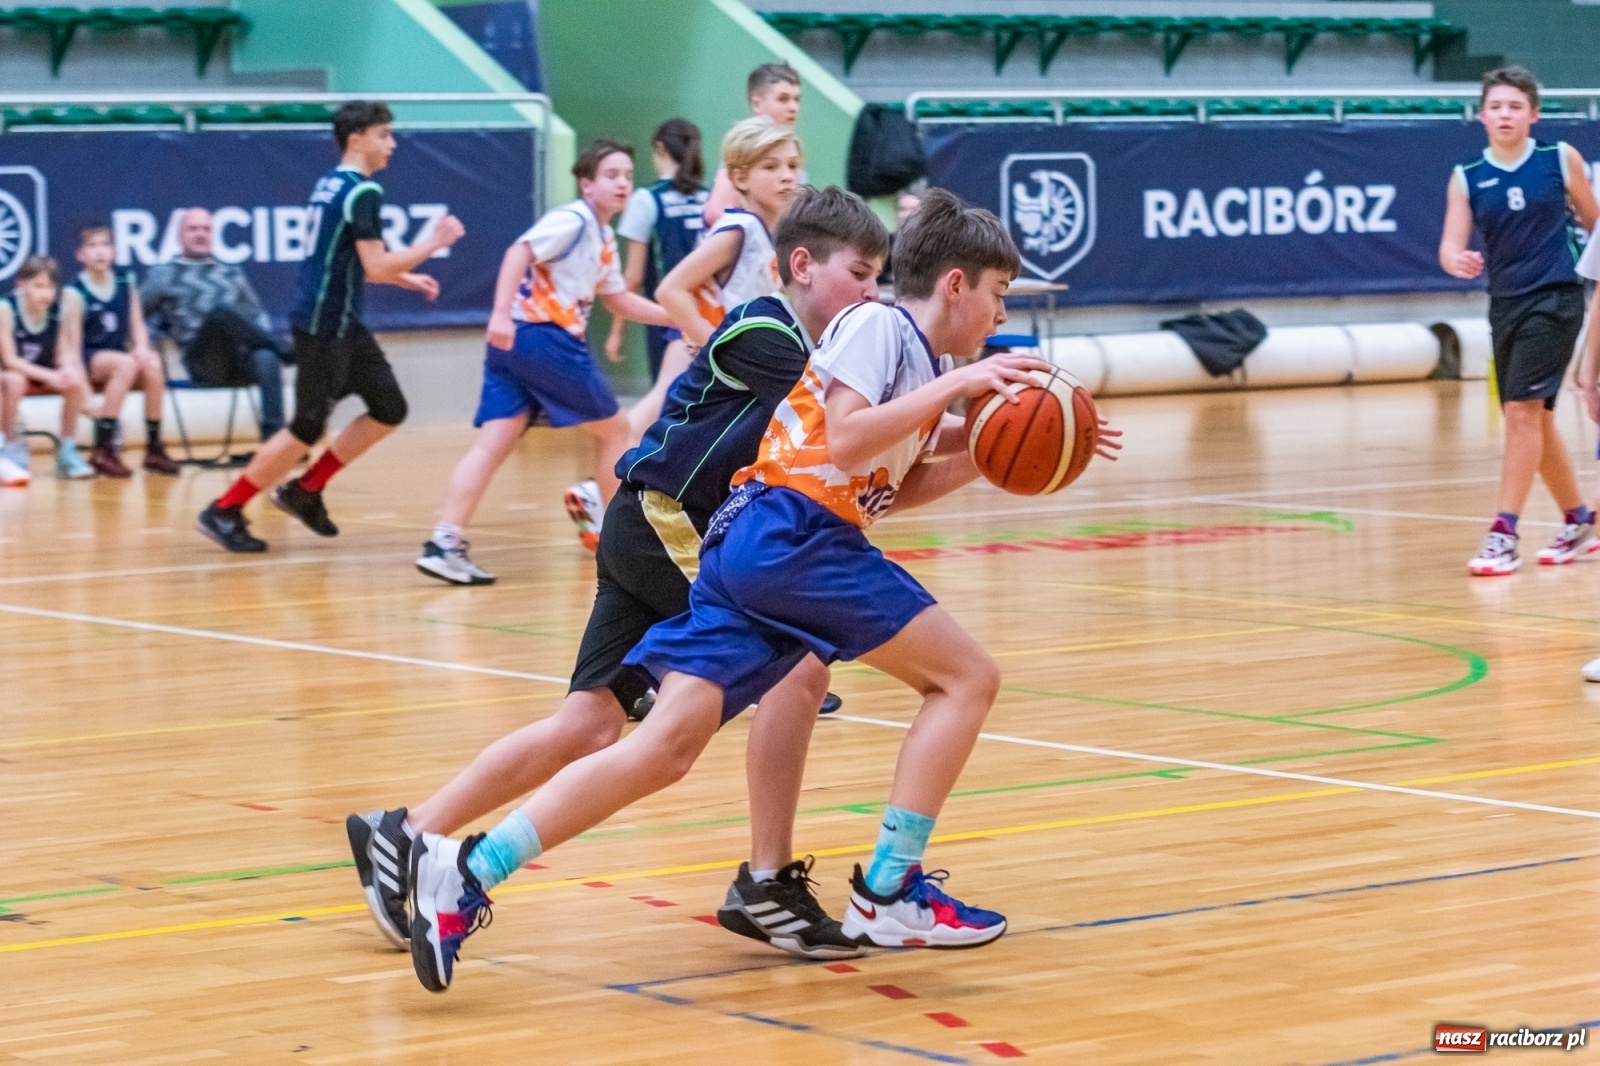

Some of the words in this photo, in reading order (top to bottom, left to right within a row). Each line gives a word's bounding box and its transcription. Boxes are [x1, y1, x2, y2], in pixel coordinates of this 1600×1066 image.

[1143, 169, 1397, 239] RACIBÓRZ
[1506, 186, 1526, 211] 8
[112, 204, 450, 266] RCIBRZ
